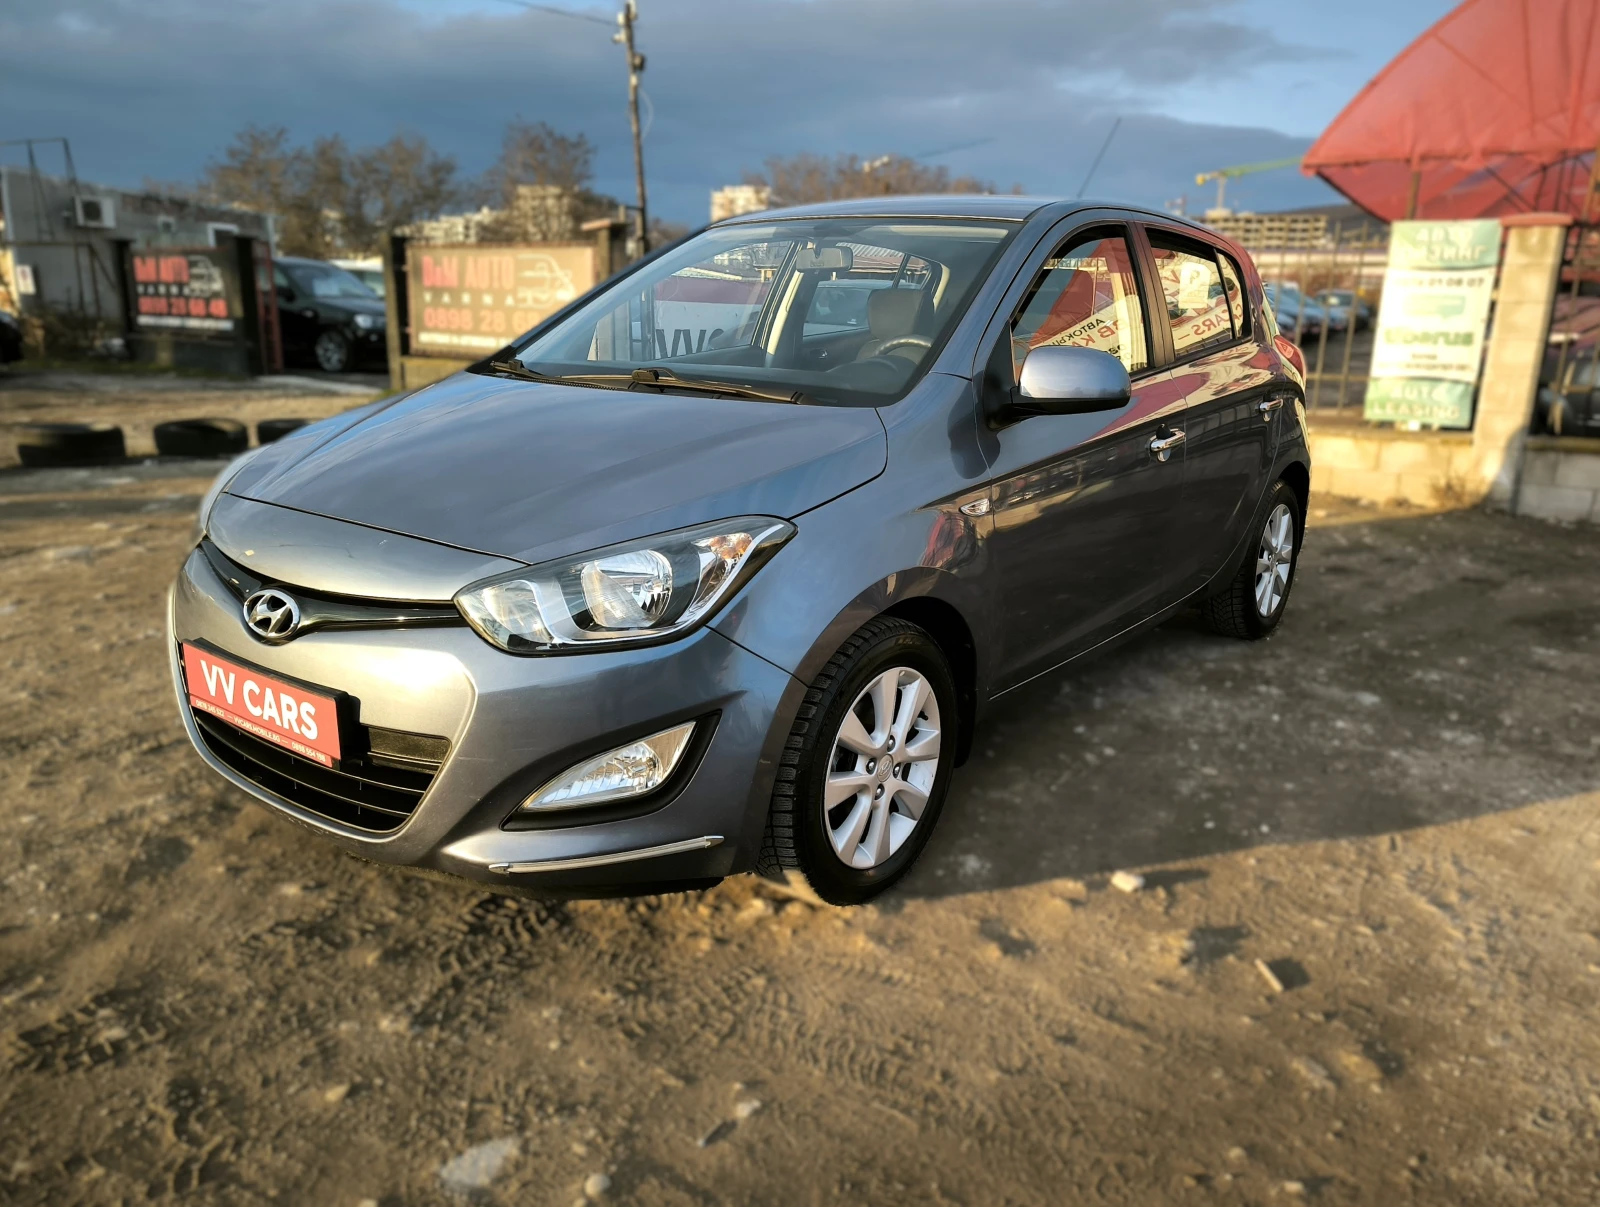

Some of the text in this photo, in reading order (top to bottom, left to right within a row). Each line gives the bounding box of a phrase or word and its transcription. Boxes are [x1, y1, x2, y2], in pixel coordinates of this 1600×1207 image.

[464, 256, 514, 289] AUTO
[423, 291, 515, 306] VARNA
[479, 310, 506, 332] 28
[200, 659, 319, 740] VV CARS
